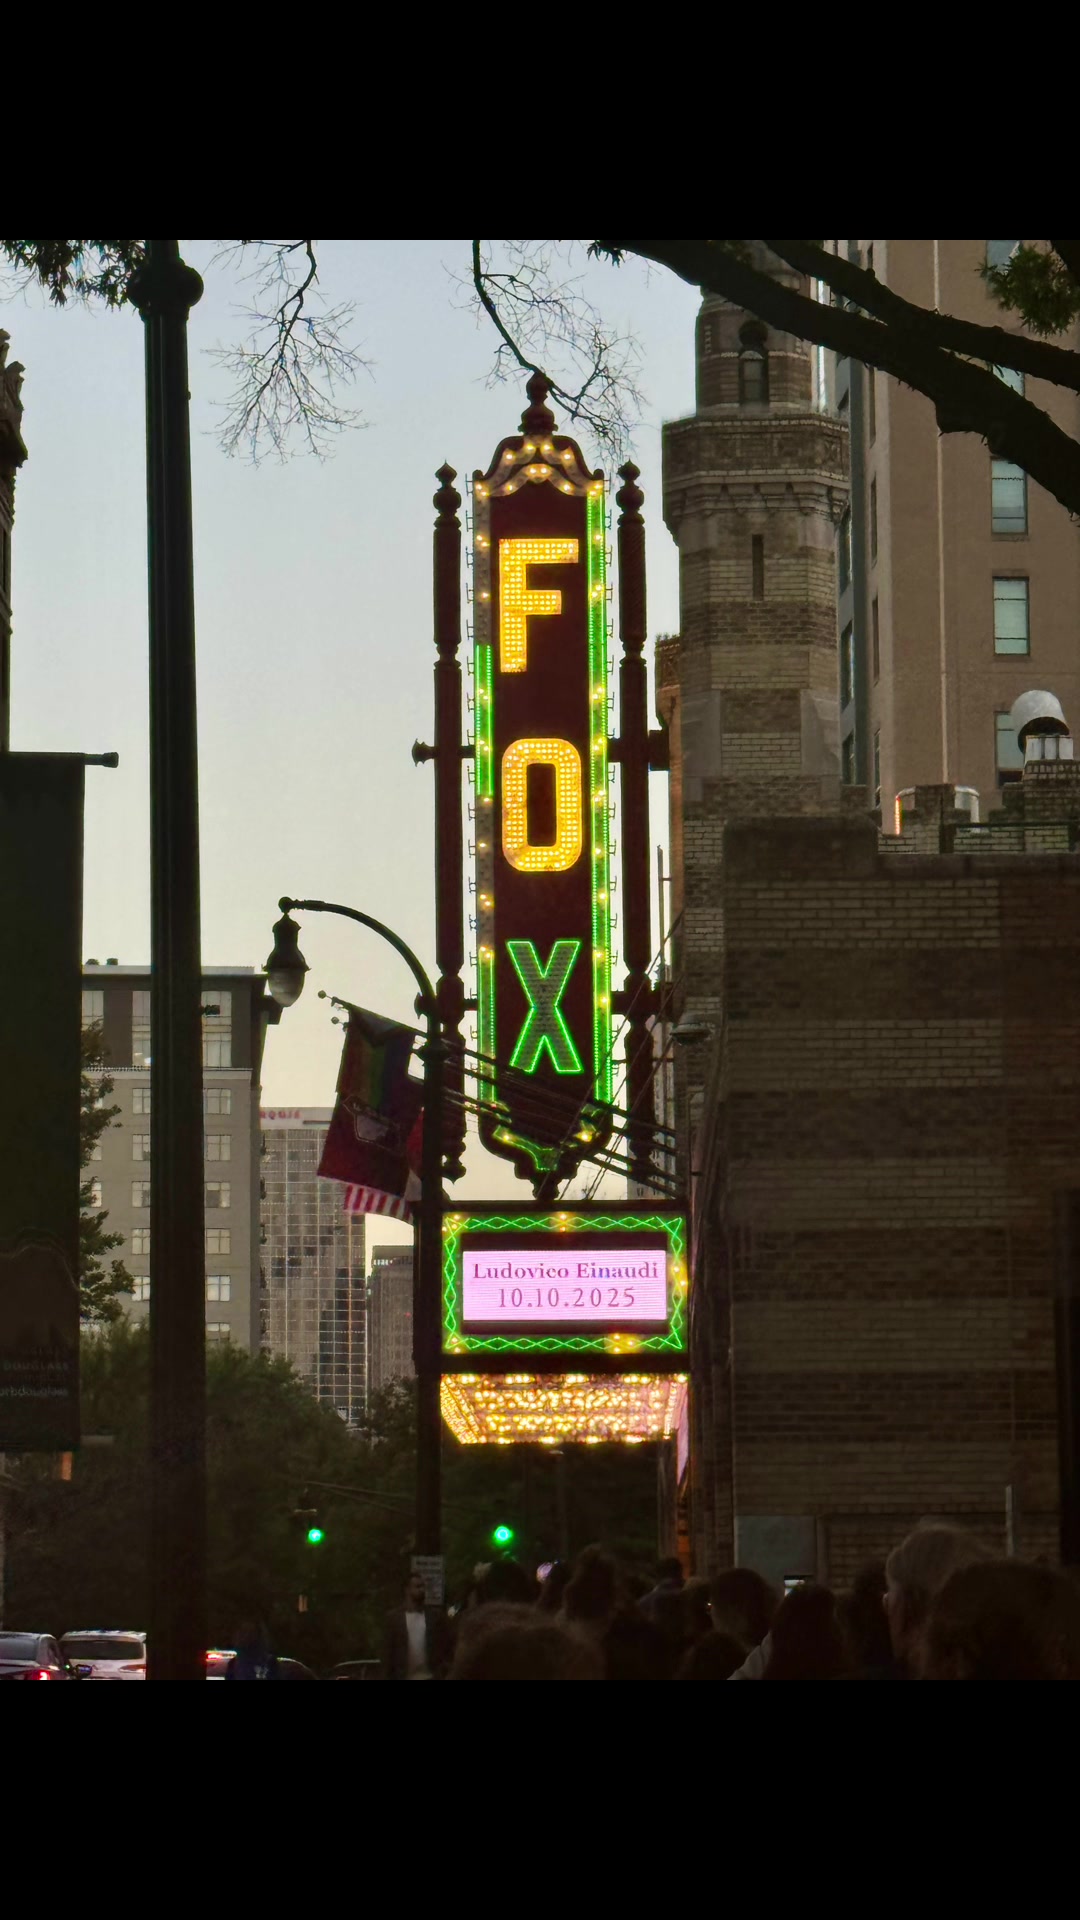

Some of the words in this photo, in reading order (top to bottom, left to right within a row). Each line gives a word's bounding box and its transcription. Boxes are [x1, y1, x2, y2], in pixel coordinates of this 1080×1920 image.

[498, 538, 584, 1074] FOX
[472, 1262, 569, 1279] Ludovico
[576, 1261, 659, 1279] Einaudi
[498, 1286, 635, 1308] 10.10.2025
